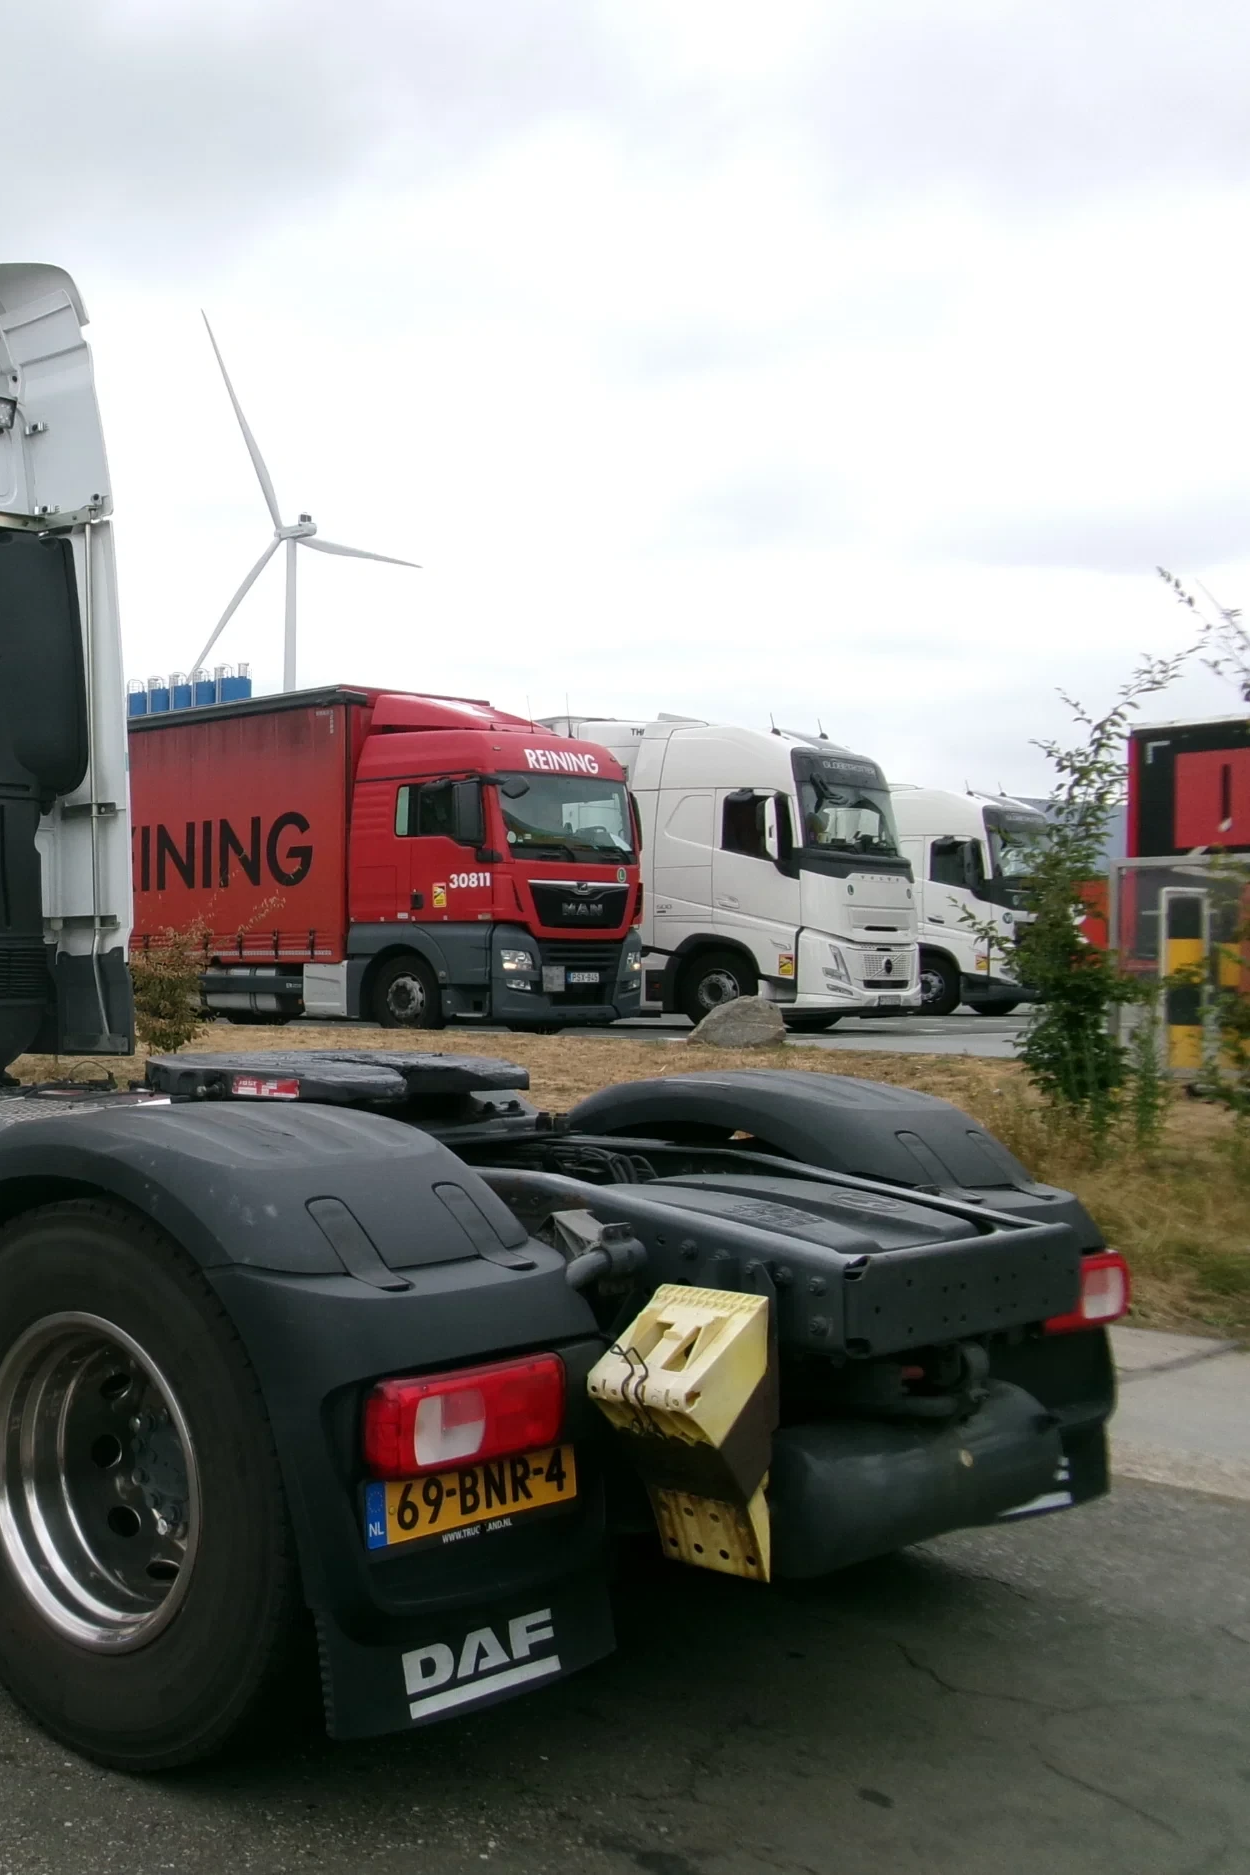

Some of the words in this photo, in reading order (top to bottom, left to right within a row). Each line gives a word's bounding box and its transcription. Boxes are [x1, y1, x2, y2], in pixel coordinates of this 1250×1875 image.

[524, 749, 599, 774] REINING
[132, 812, 313, 893] INING
[449, 872, 491, 888] 30811
[562, 902, 603, 916] MAN
[369, 1521, 384, 1537] NL
[397, 1448, 566, 1531] 69-BNR-4
[401, 1608, 554, 1695] DAF
